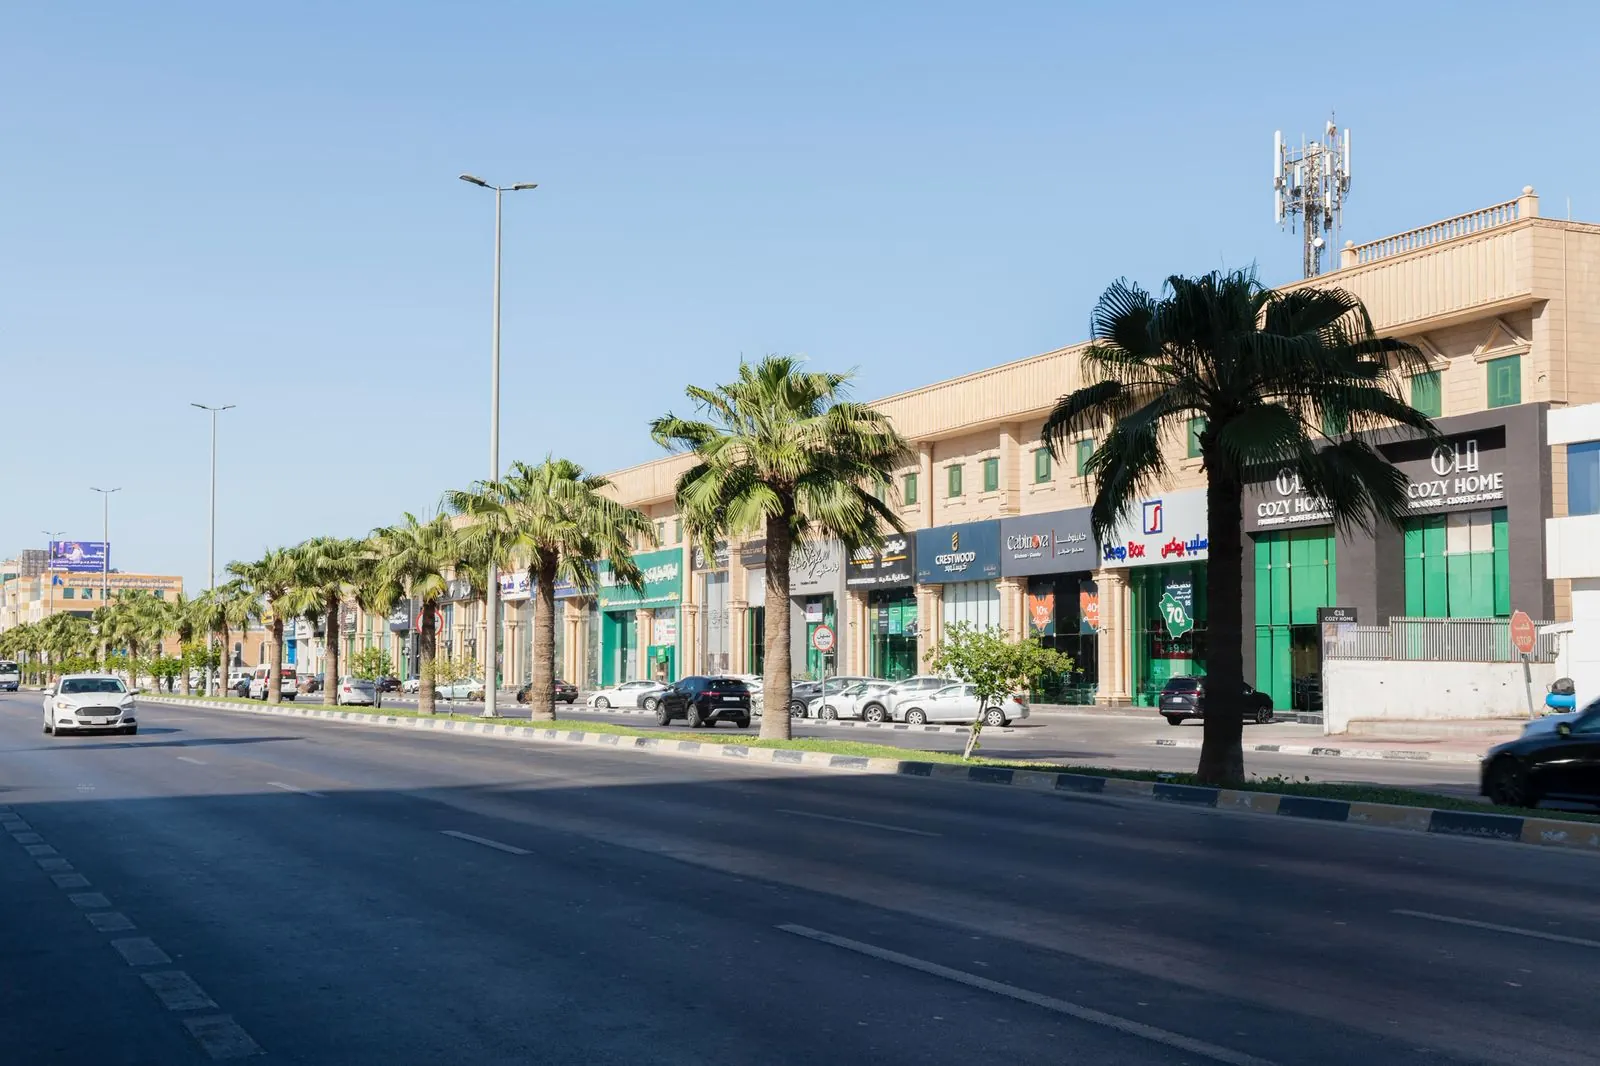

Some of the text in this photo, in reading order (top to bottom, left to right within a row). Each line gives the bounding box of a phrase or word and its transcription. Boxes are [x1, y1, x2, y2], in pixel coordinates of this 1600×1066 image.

[1407, 472, 1504, 499] COZY HOME
[1257, 499, 1292, 517] COZY
[1007, 534, 1049, 551] Cabinova
[1128, 541, 1146, 559] Box
[935, 551, 976, 565] CRESTWOOD
[1516, 635, 1532, 645] STOP
